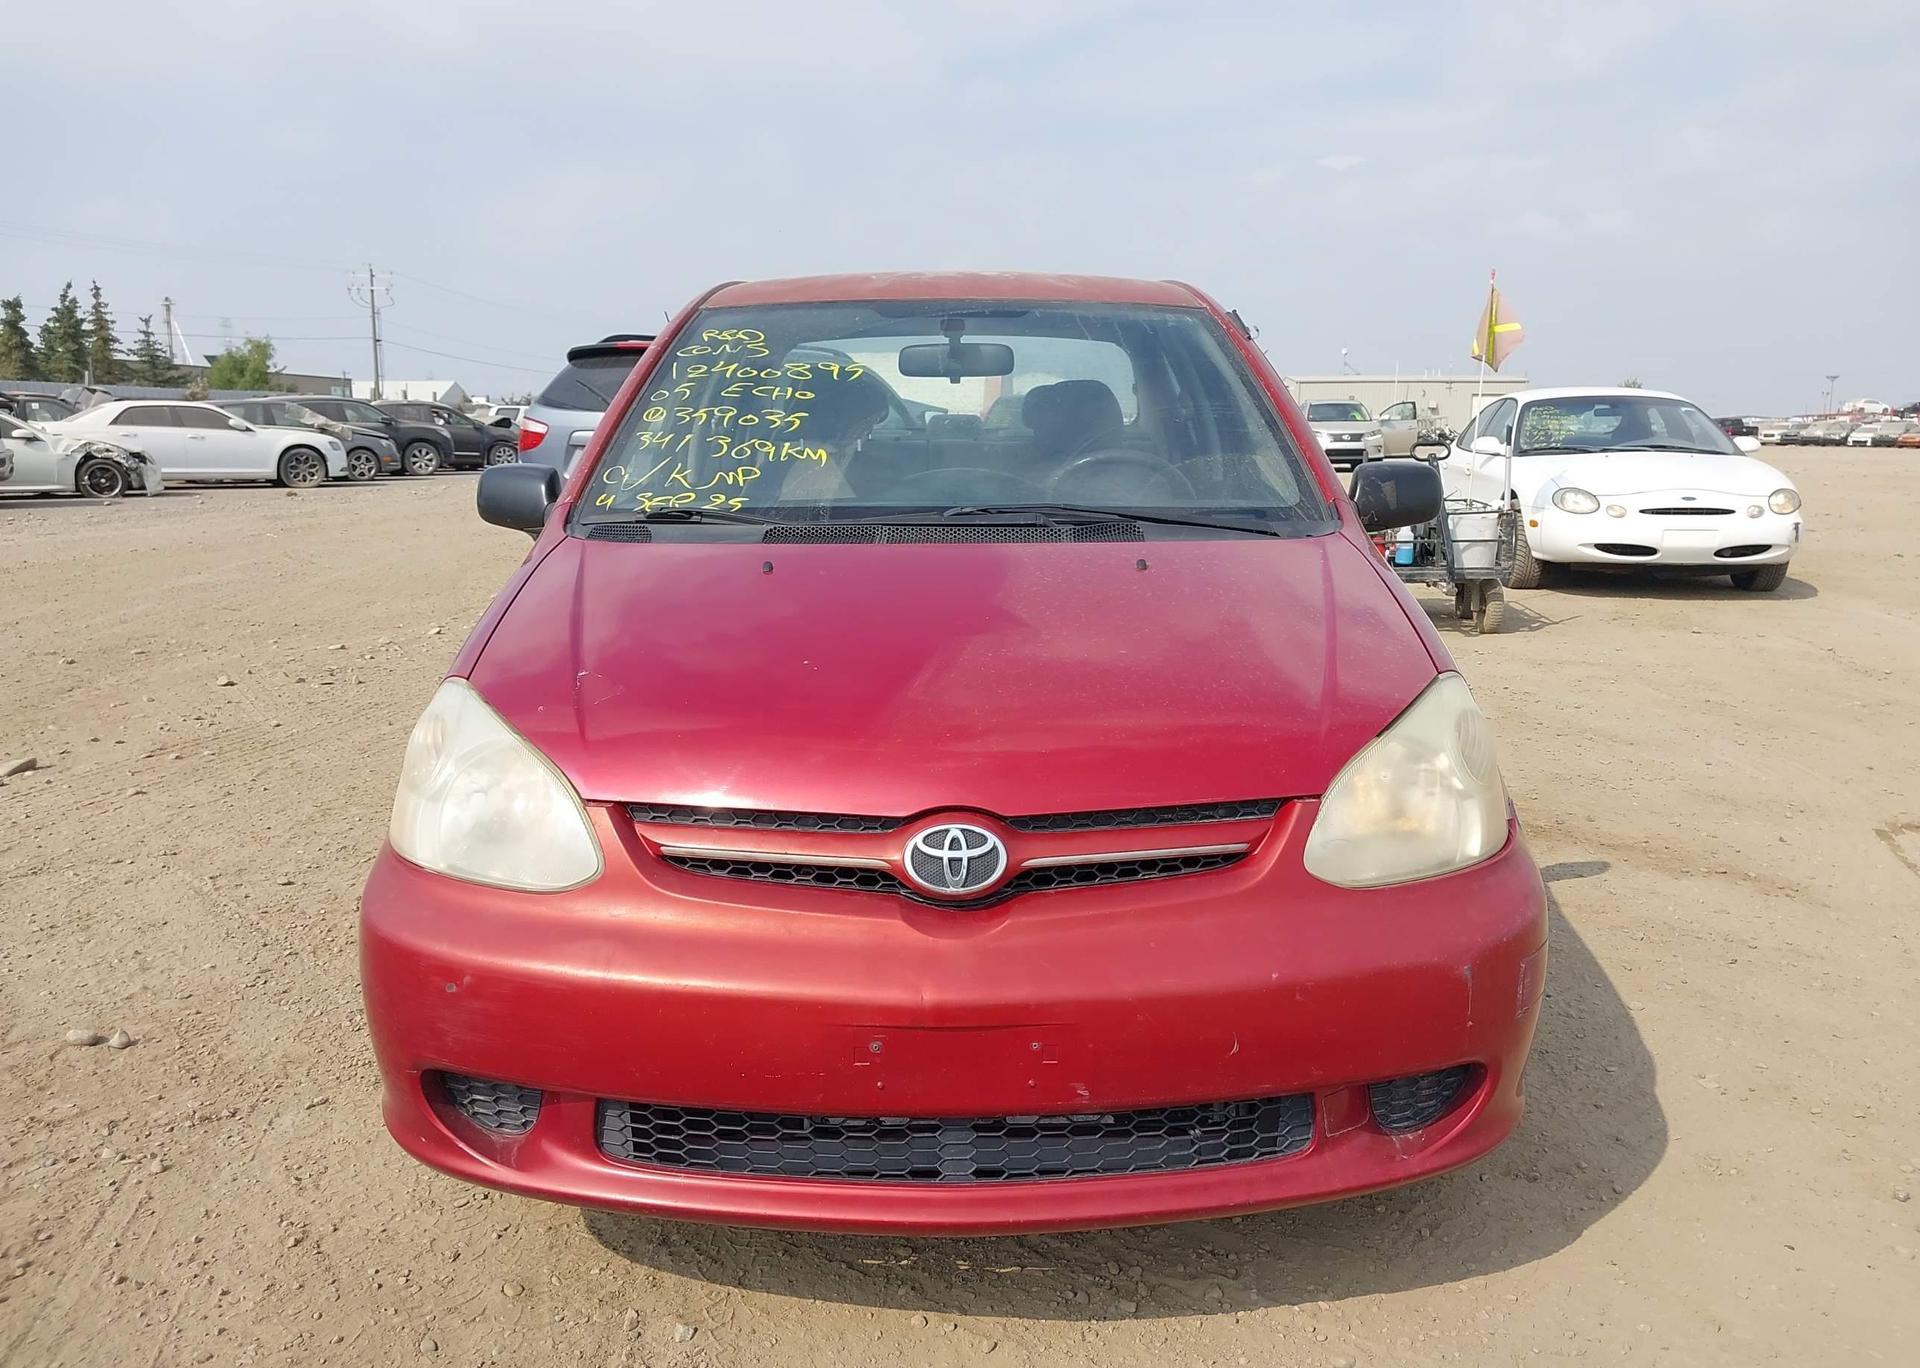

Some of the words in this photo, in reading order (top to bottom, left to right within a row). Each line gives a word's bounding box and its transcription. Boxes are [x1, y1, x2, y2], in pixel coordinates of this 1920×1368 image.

[672, 361, 864, 380] 12400895
[650, 382, 696, 402] 05
[720, 382, 816, 401] ECHO
[702, 493, 750, 512] 25
